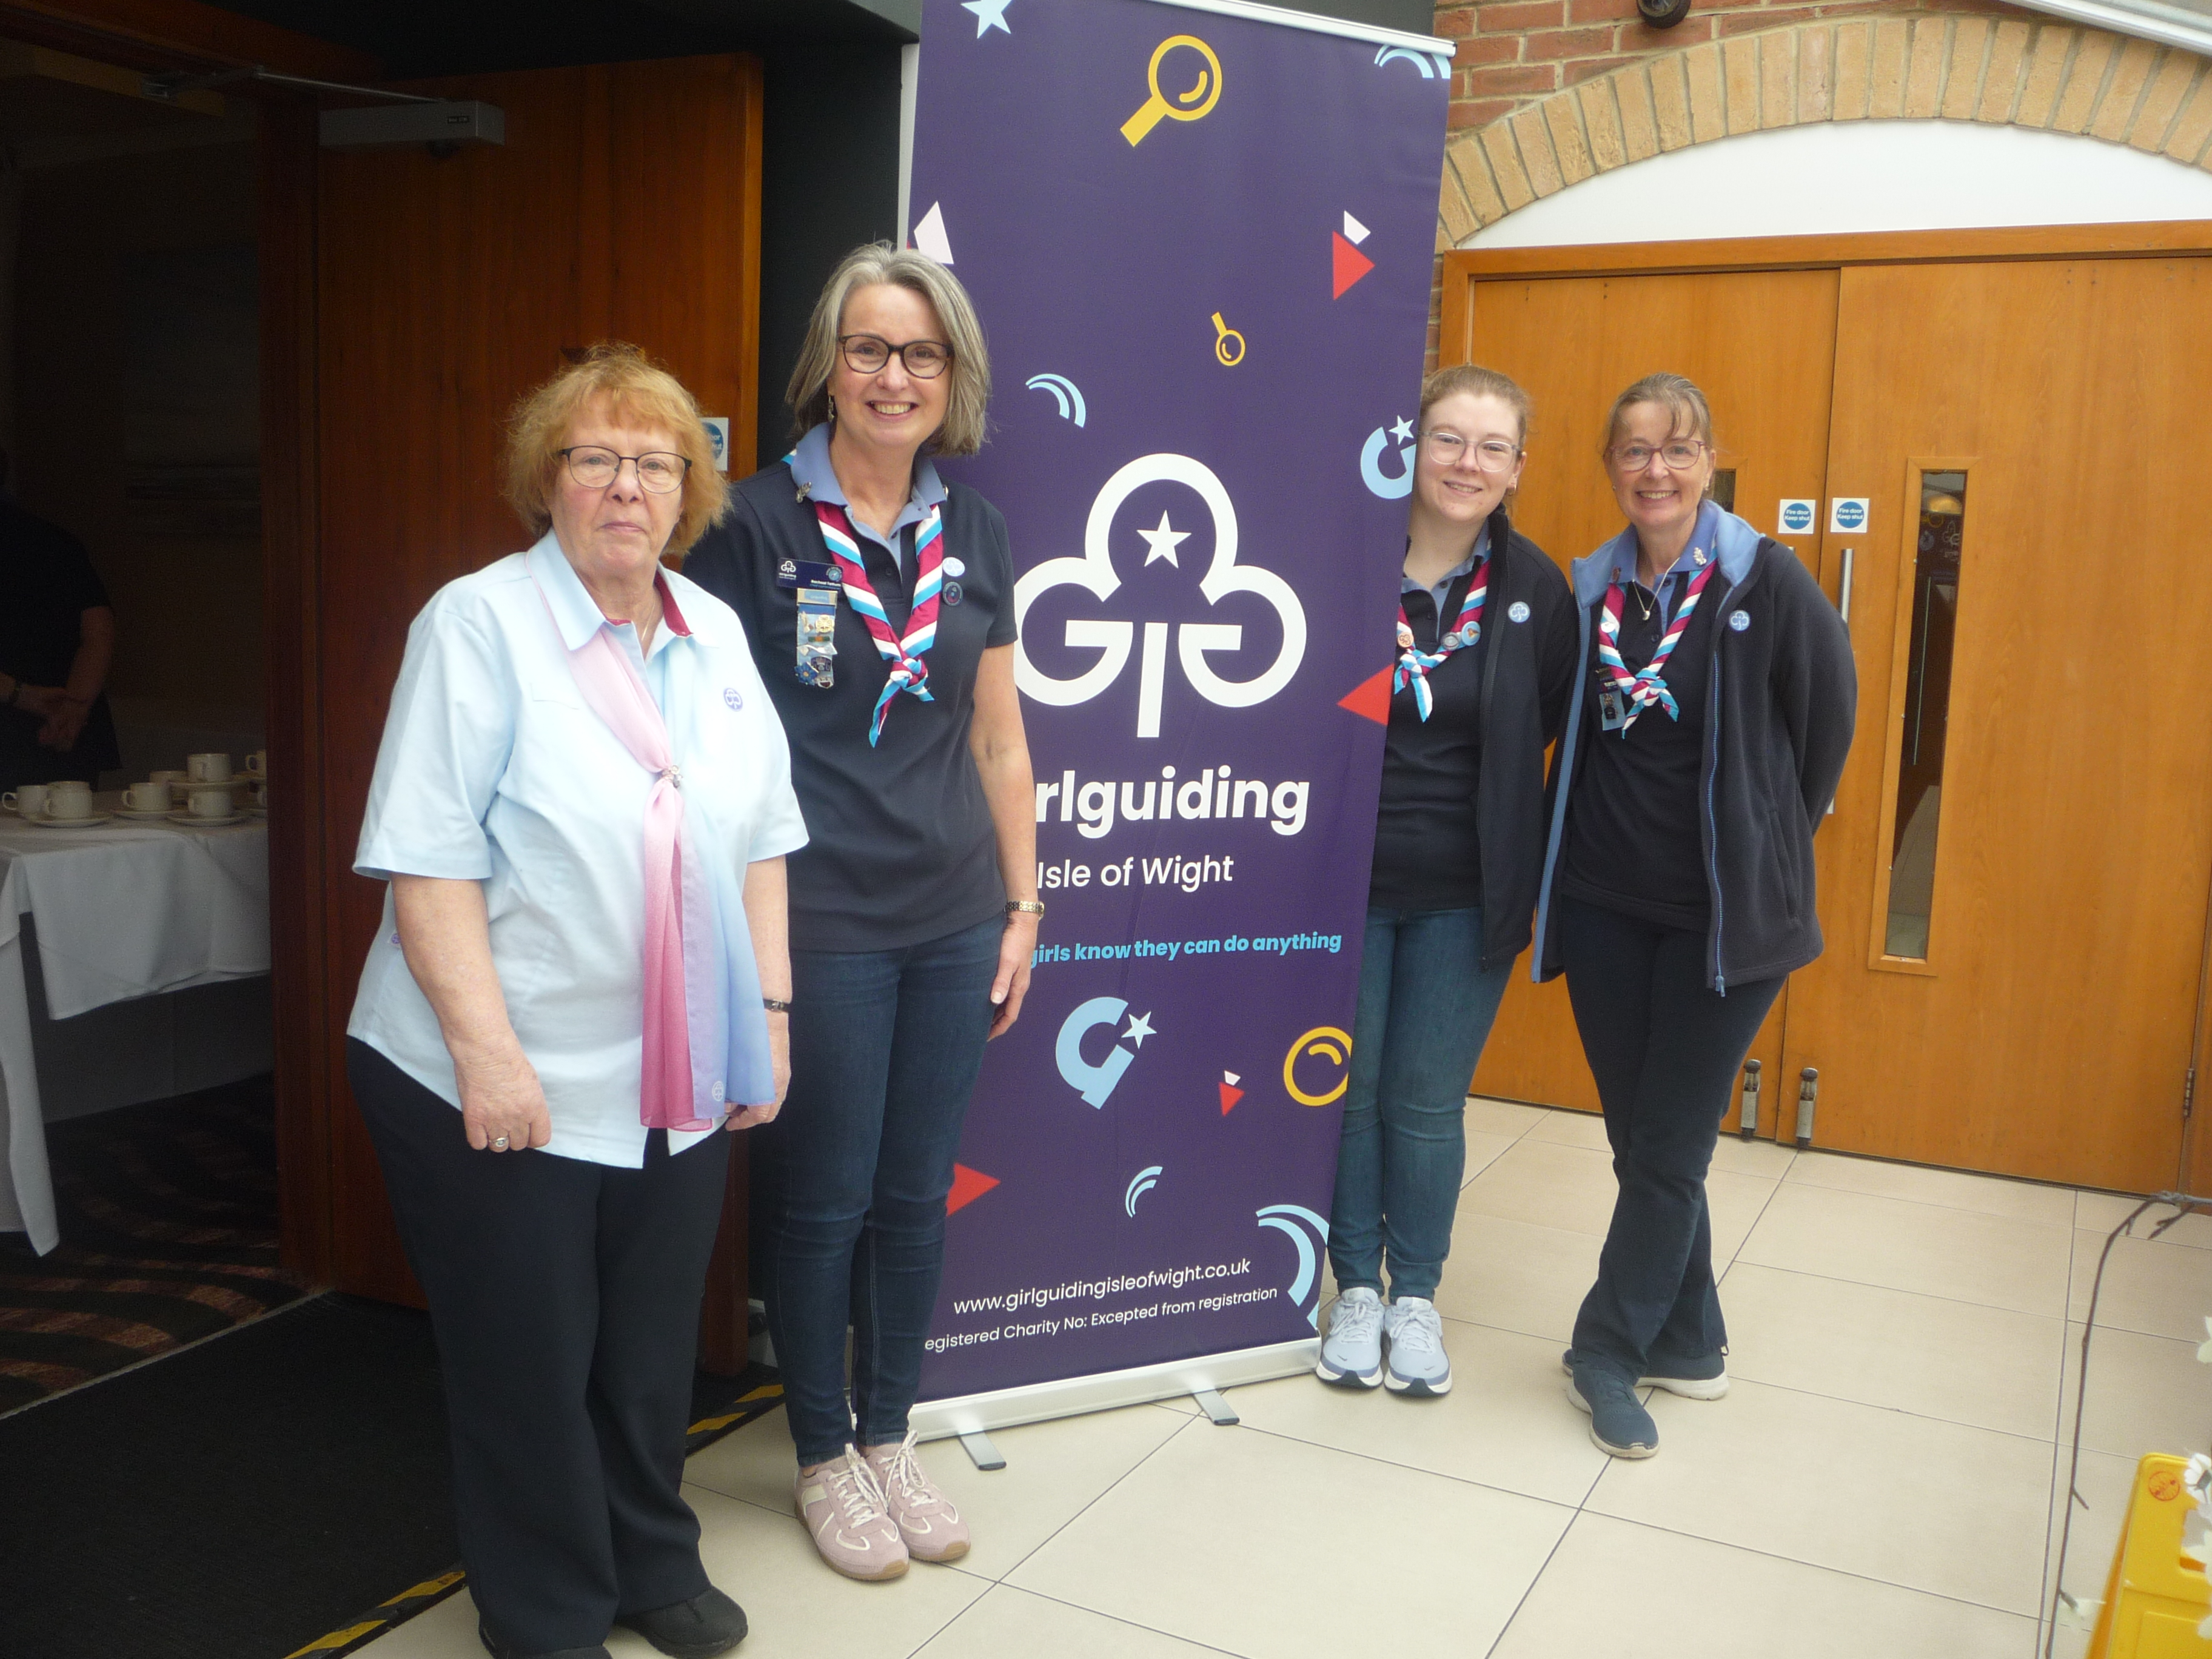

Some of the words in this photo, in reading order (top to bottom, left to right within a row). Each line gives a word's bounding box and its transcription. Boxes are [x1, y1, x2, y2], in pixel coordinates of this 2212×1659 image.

[1036, 765, 1310, 839] rlguiding
[1037, 859, 1091, 889] Isle
[1100, 856, 1134, 886] of
[1142, 854, 1234, 893] Wight
[1074, 943, 1131, 960] know
[1134, 939, 1181, 961] they
[1184, 939, 1221, 954] can
[1224, 934, 1249, 952] do
[1252, 931, 1342, 956] anything
[954, 1258, 1251, 1315] www.girlguidingisleofwight.co.uk
[925, 1327, 1000, 1353] egistered
[1004, 1319, 1061, 1339] Charity
[1064, 1316, 1088, 1331] No:
[1091, 1304, 1159, 1327] Excepted
[1161, 1301, 1196, 1316] from
[1199, 1285, 1278, 1311] registration
